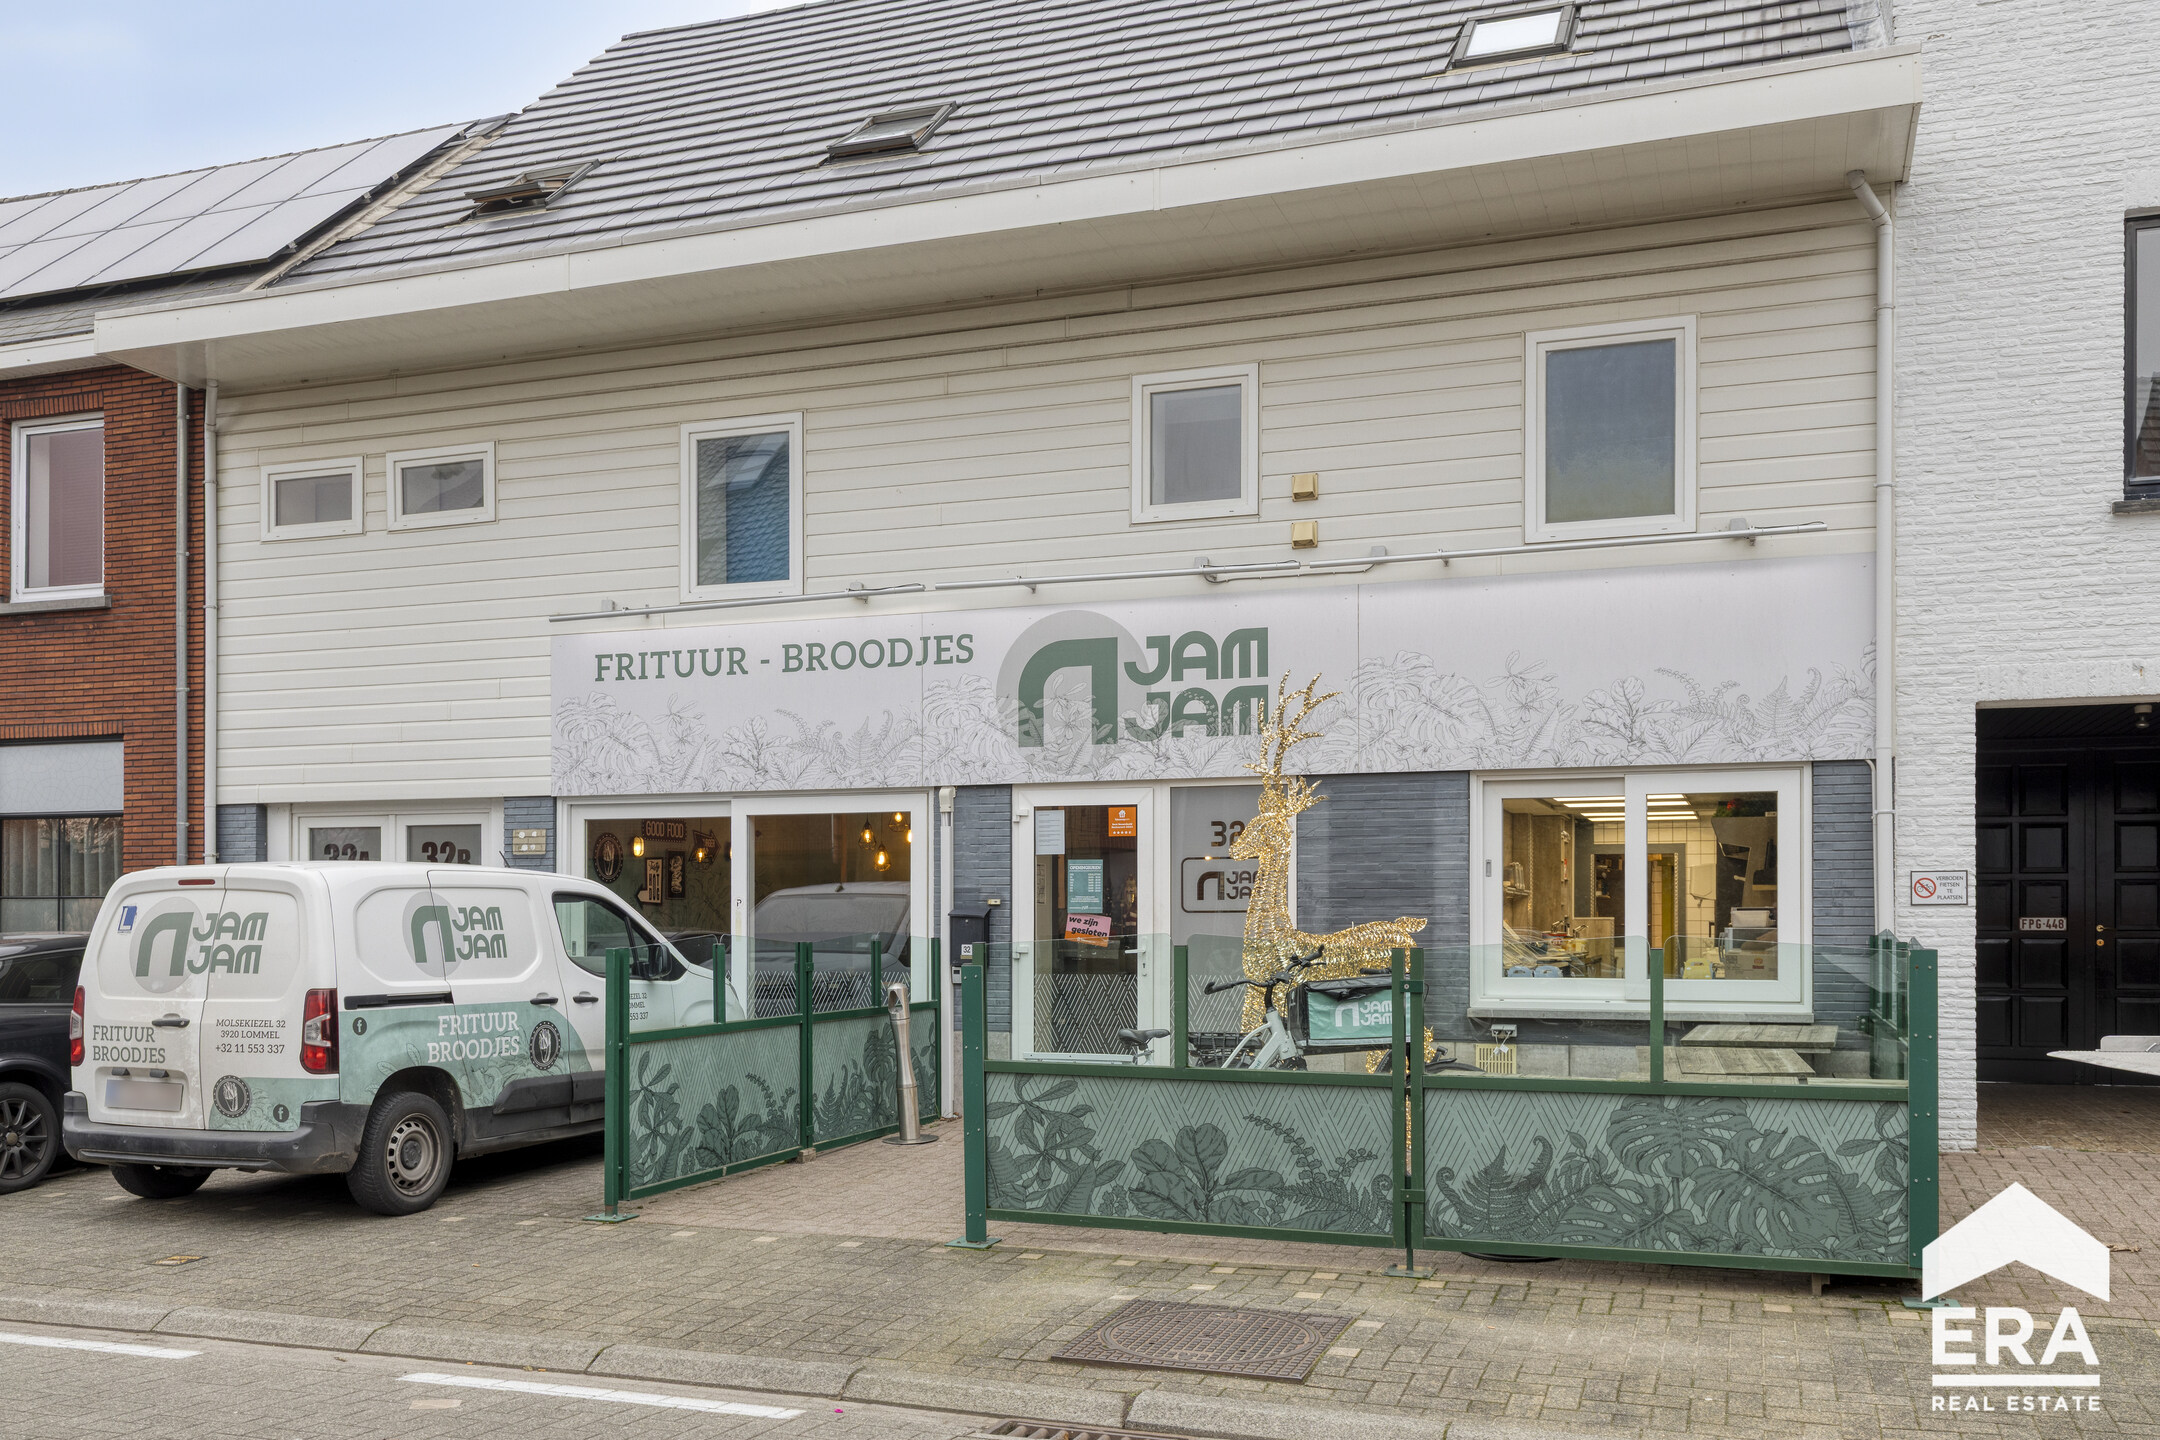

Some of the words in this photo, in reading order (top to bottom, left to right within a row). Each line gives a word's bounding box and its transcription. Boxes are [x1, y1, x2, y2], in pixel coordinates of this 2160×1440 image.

[595, 647, 747, 682] FRITUUR
[780, 633, 975, 672] BROODJES
[1124, 627, 1268, 685] JAM
[1124, 685, 1268, 741] JAM
[646, 821, 665, 837] GOOD
[667, 822, 684, 839] FOOD
[1211, 821, 1245, 847] 32
[421, 841, 471, 864] 32B
[1226, 886, 1252, 899] JA
[193, 912, 269, 941] JAM
[452, 906, 504, 932] JAM
[1069, 916, 1082, 924] we
[1083, 918, 1099, 928] zijn
[1071, 926, 1108, 938] gesloten
[456, 934, 508, 960] JAM
[963, 945, 971, 953] 32
[187, 944, 262, 974] JAM
[1360, 1000, 1393, 1013] JAM
[216, 1019, 274, 1028] MOLSEKIEZEL
[276, 1020, 286, 1028] 32
[438, 1011, 520, 1037] FRITUUR
[639, 1011, 649, 1020] 337
[1360, 1013, 1393, 1025] JAM
[93, 1025, 155, 1042] FRITUUR
[220, 1030, 239, 1039] 3920
[241, 1031, 280, 1039] LOMMEL
[93, 1046, 166, 1063] BROODJES
[215, 1043, 232, 1053] +32
[235, 1044, 245, 1053] 11
[247, 1044, 265, 1053] 553
[267, 1044, 285, 1054] 337
[427, 1035, 520, 1063] BROODJES
